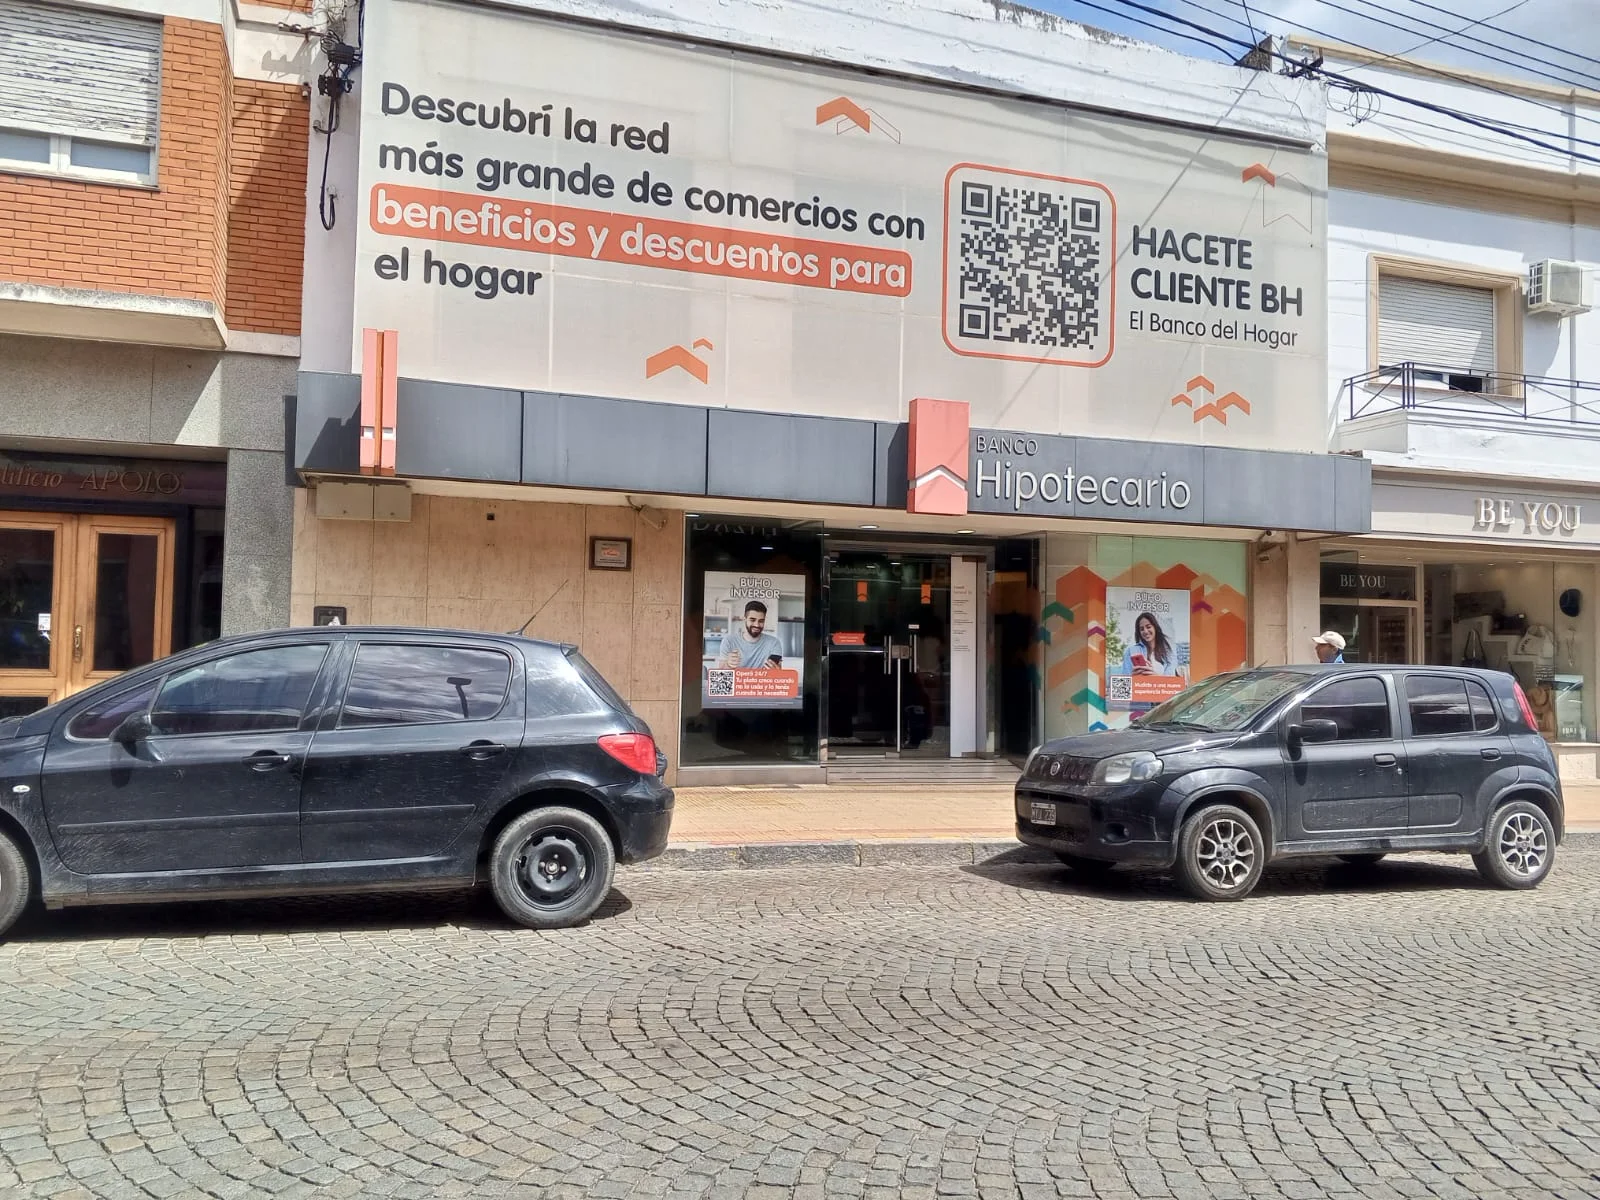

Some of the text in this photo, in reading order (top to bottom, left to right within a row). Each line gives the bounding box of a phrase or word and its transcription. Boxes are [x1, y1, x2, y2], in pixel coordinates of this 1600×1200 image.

[381, 82, 670, 154] Descubrí la red
[379, 141, 925, 241] más grande de comercios con
[377, 189, 906, 289] beneficios y descuentos para
[1132, 225, 1253, 270] HACETE
[374, 247, 542, 300] el hogar
[1131, 268, 1303, 317] CLIENTE BH
[1129, 310, 1299, 349] El Banco del Hogar
[976, 436, 1039, 455] BANCO
[80, 466, 180, 494] APOLO
[975, 459, 1191, 510] Hipotecario
[1477, 498, 1584, 531] BE YOU
[730, 587, 780, 600] INVERSOR
[1340, 574, 1386, 588] BE YOU
